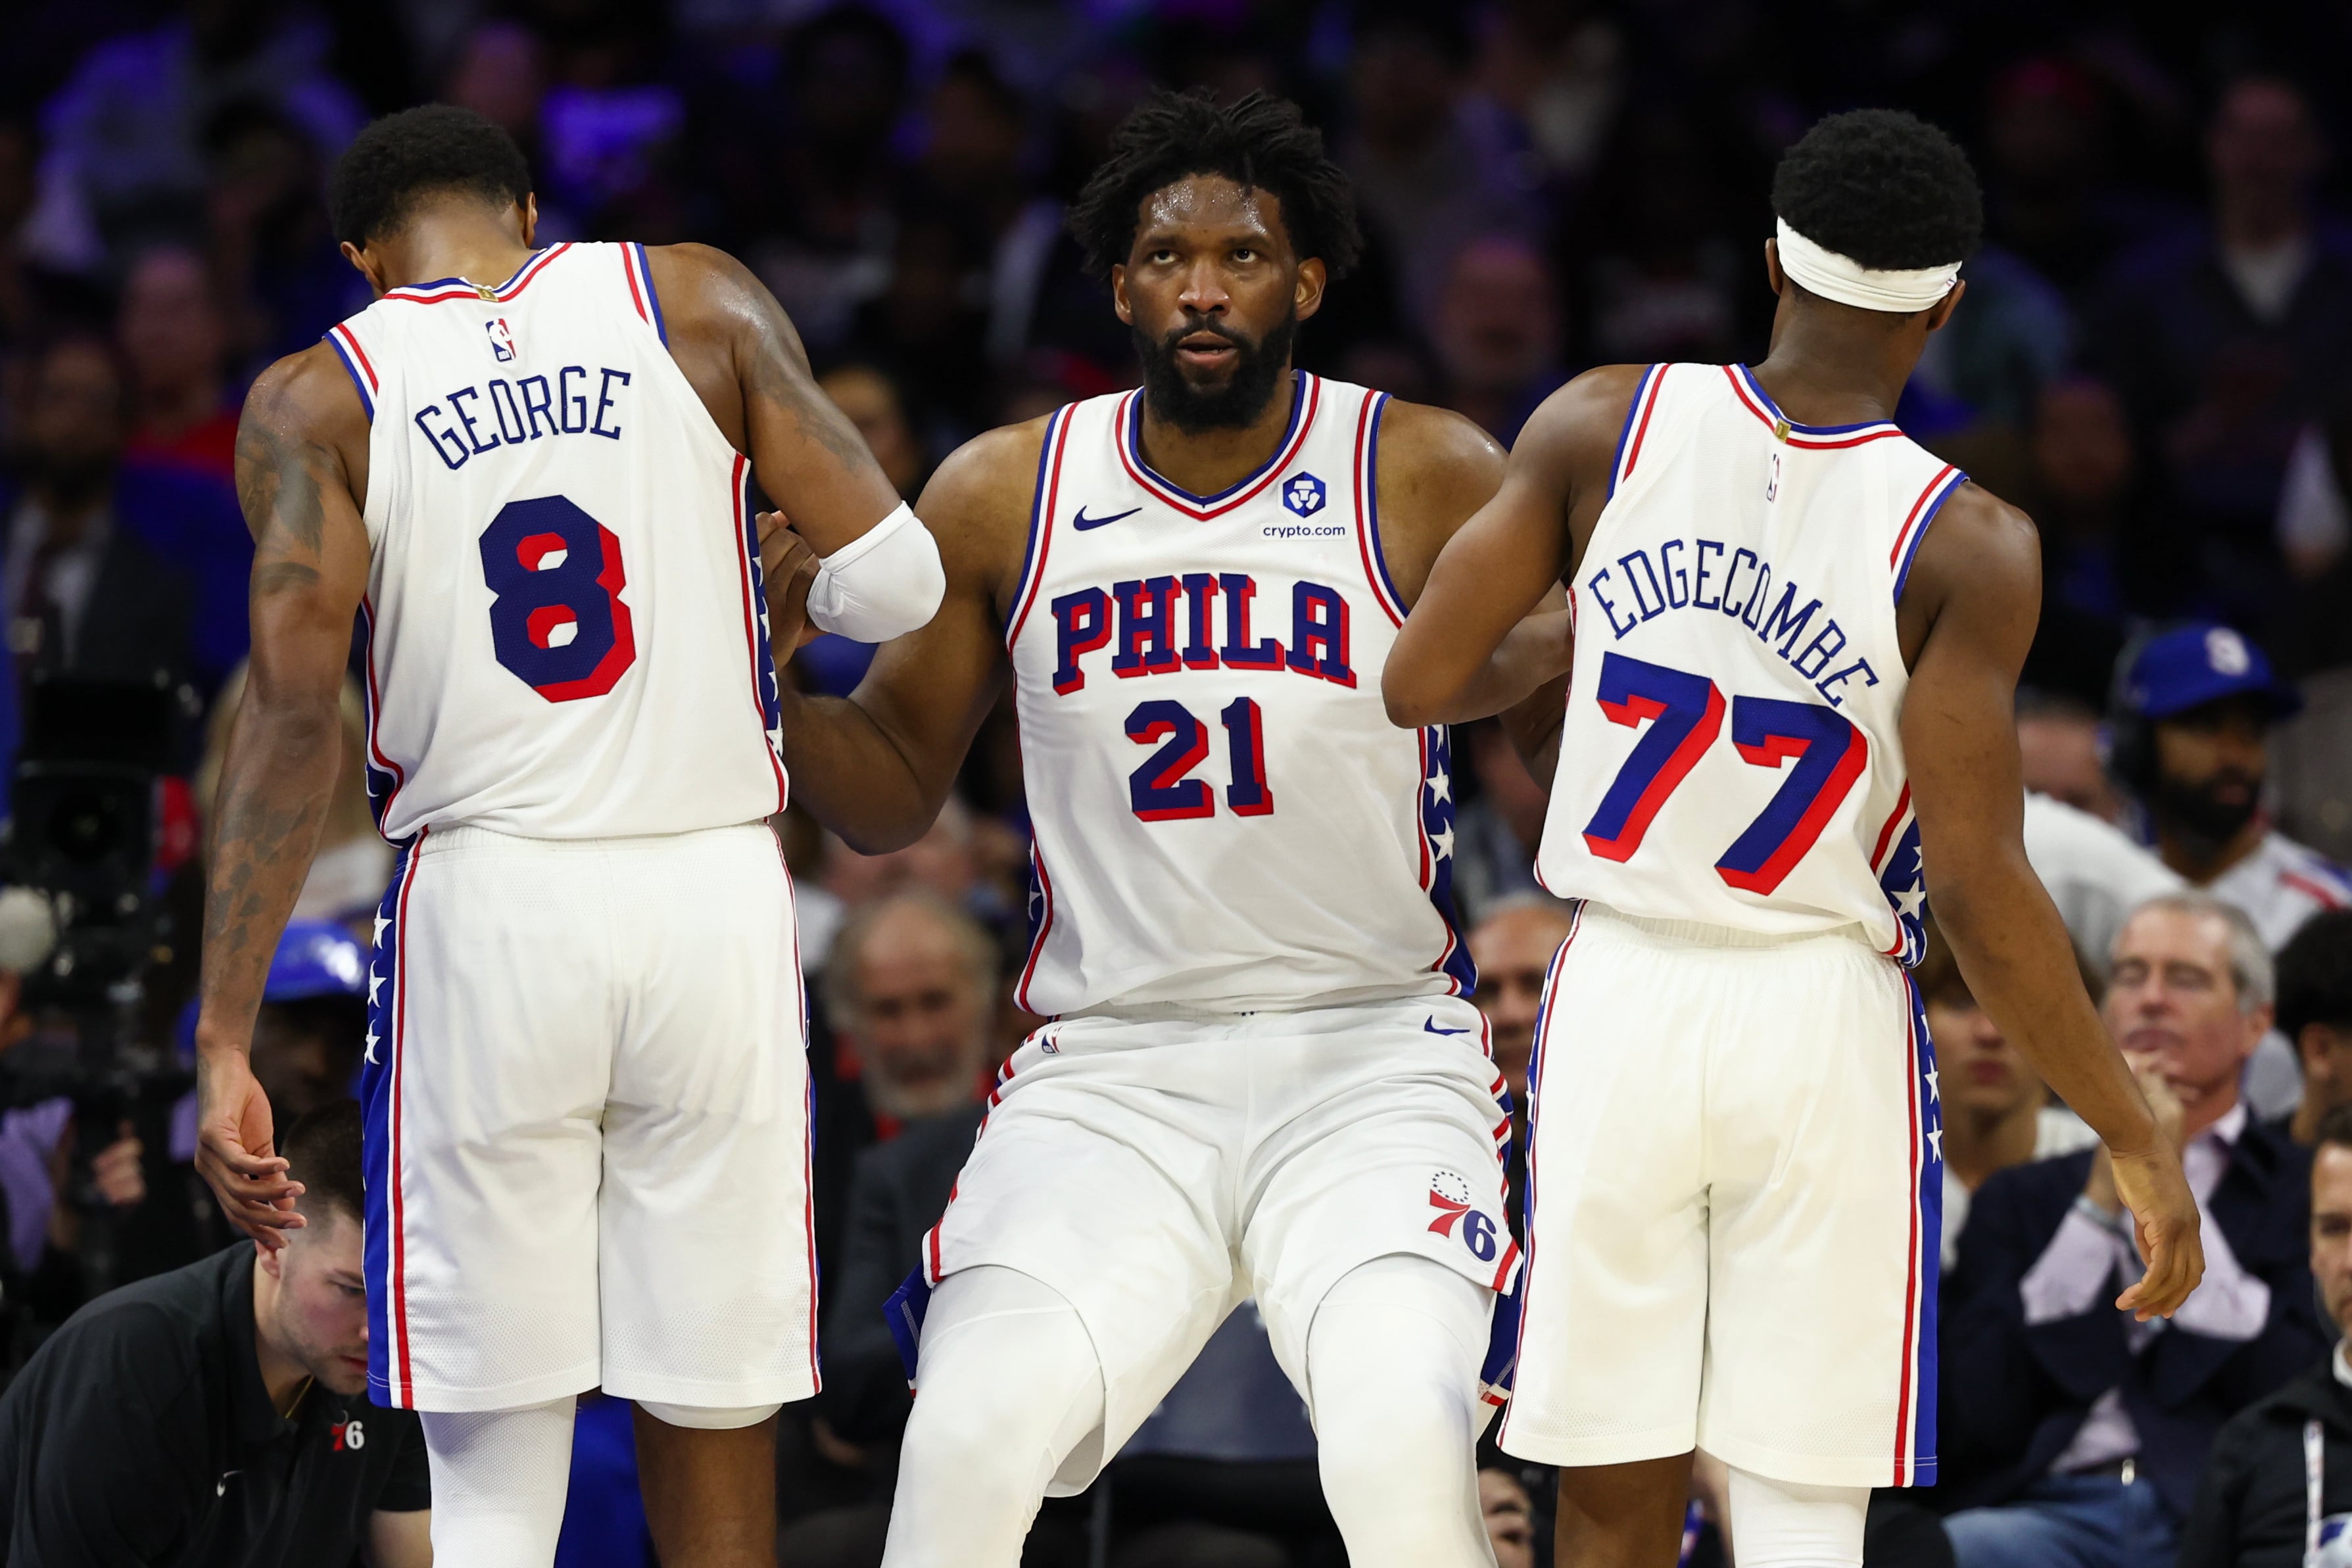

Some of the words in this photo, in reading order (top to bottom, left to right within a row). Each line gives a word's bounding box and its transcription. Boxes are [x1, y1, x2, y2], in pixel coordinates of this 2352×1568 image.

[414, 366, 631, 470] GEORGE
[1263, 525, 1345, 538] crypto.com
[479, 494, 636, 703] 8
[1051, 573, 1356, 696] PHILA
[1589, 538, 1879, 707] EDGECOMBE
[1124, 696, 1274, 822] 21
[1582, 651, 1867, 896] 77
[1428, 1189, 1497, 1262] 76
[331, 1420, 364, 1452] 76
